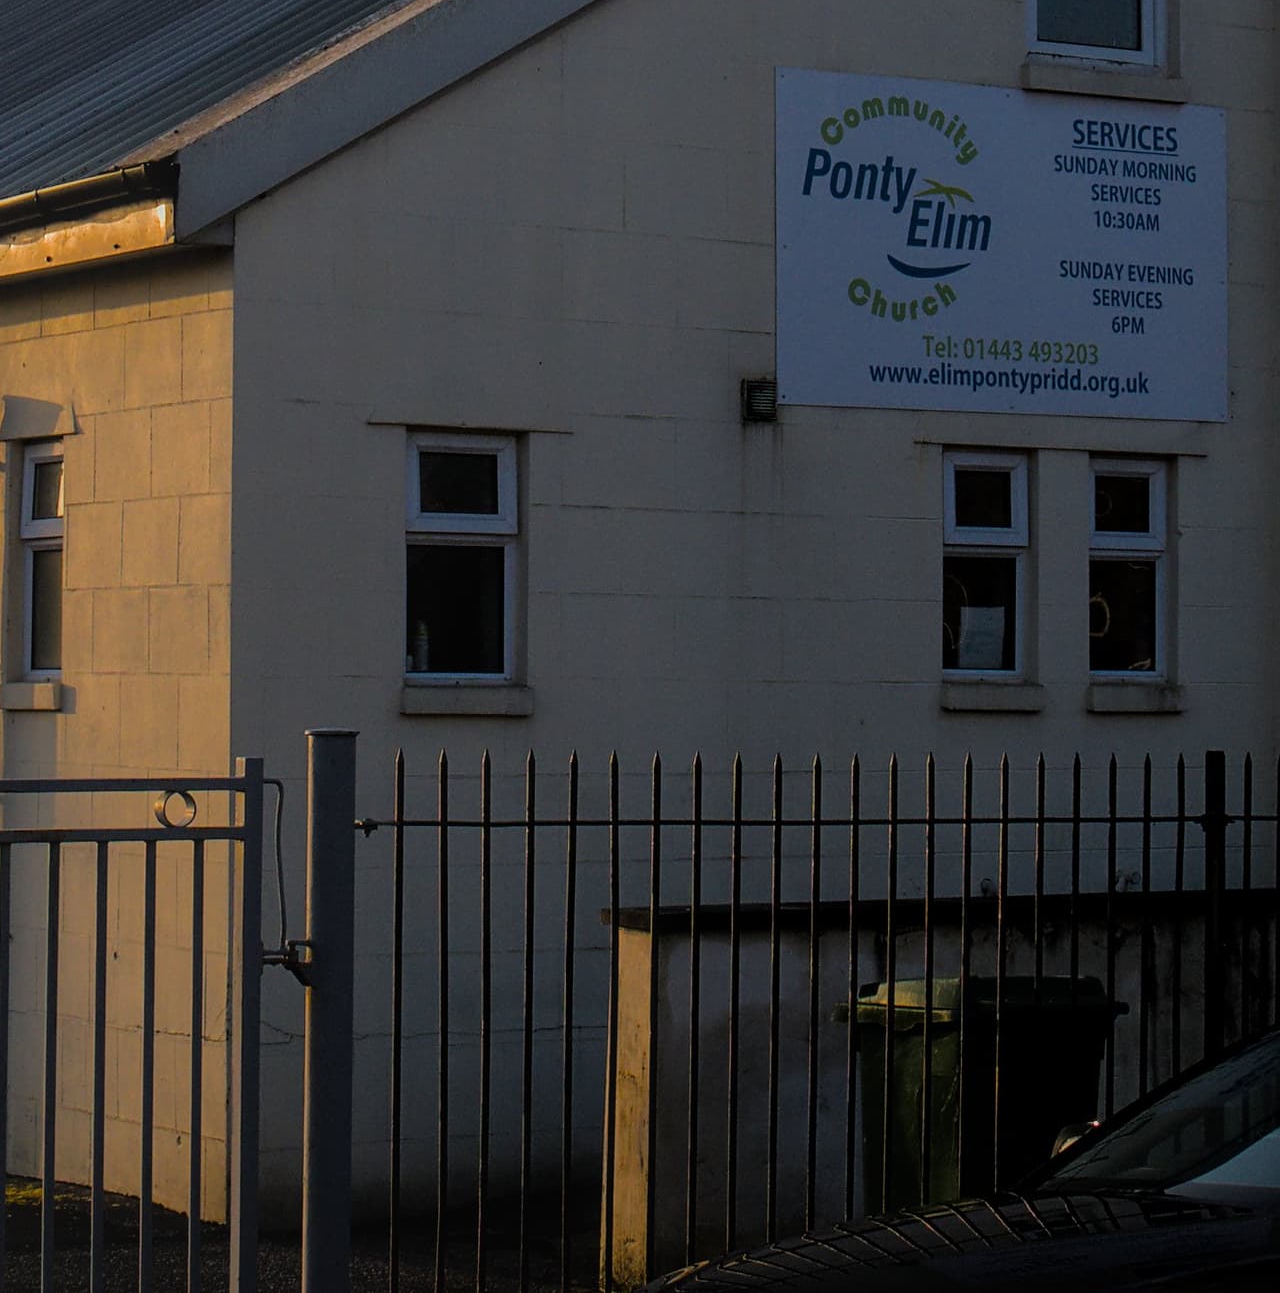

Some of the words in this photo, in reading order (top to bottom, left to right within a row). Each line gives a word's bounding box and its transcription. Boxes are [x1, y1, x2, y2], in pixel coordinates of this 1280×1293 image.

[820, 96, 979, 165] Community
[1072, 119, 1178, 152] SERVICES
[803, 148, 917, 214] Ponty
[1055, 155, 1118, 176] SUNDAY
[1123, 160, 1196, 183] MORNING
[1091, 184, 1161, 206] SERVICES
[907, 199, 992, 250] Elim
[1094, 210, 1160, 231] 10:30AM
[1060, 260, 1124, 280] SUNDAY
[1128, 265, 1193, 285] EVENING
[847, 278, 957, 322] Church
[1093, 289, 1162, 310] SERVICES
[1112, 316, 1144, 335] 6PM
[922, 336, 958, 358] Tel:
[964, 338, 1022, 361] 01443
[1028, 341, 1099, 365] 493203
[870, 363, 1149, 398] www.elimpontypridd.org.uk
